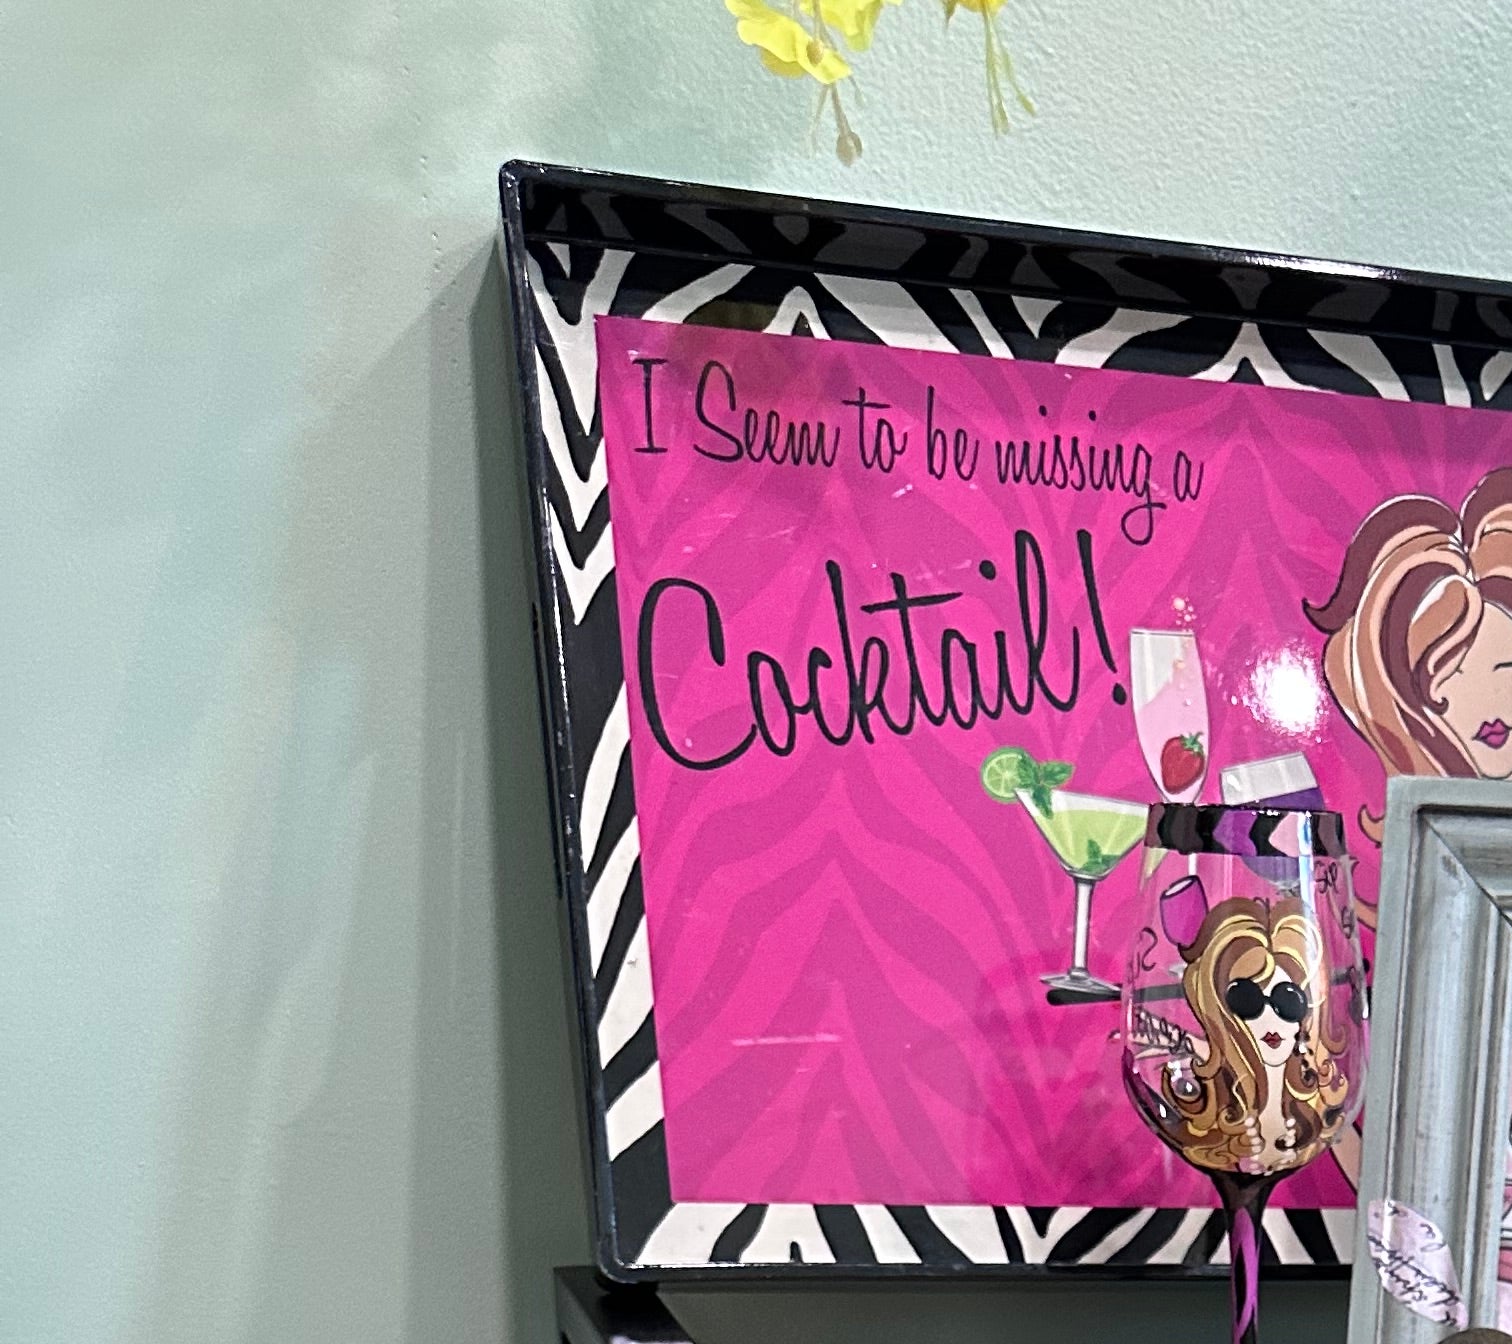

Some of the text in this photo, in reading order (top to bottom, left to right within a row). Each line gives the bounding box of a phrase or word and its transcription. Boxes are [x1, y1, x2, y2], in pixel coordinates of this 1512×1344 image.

[632, 357, 1204, 545] I Seem to be missing a
[637, 528, 1128, 772] Cocktail!
